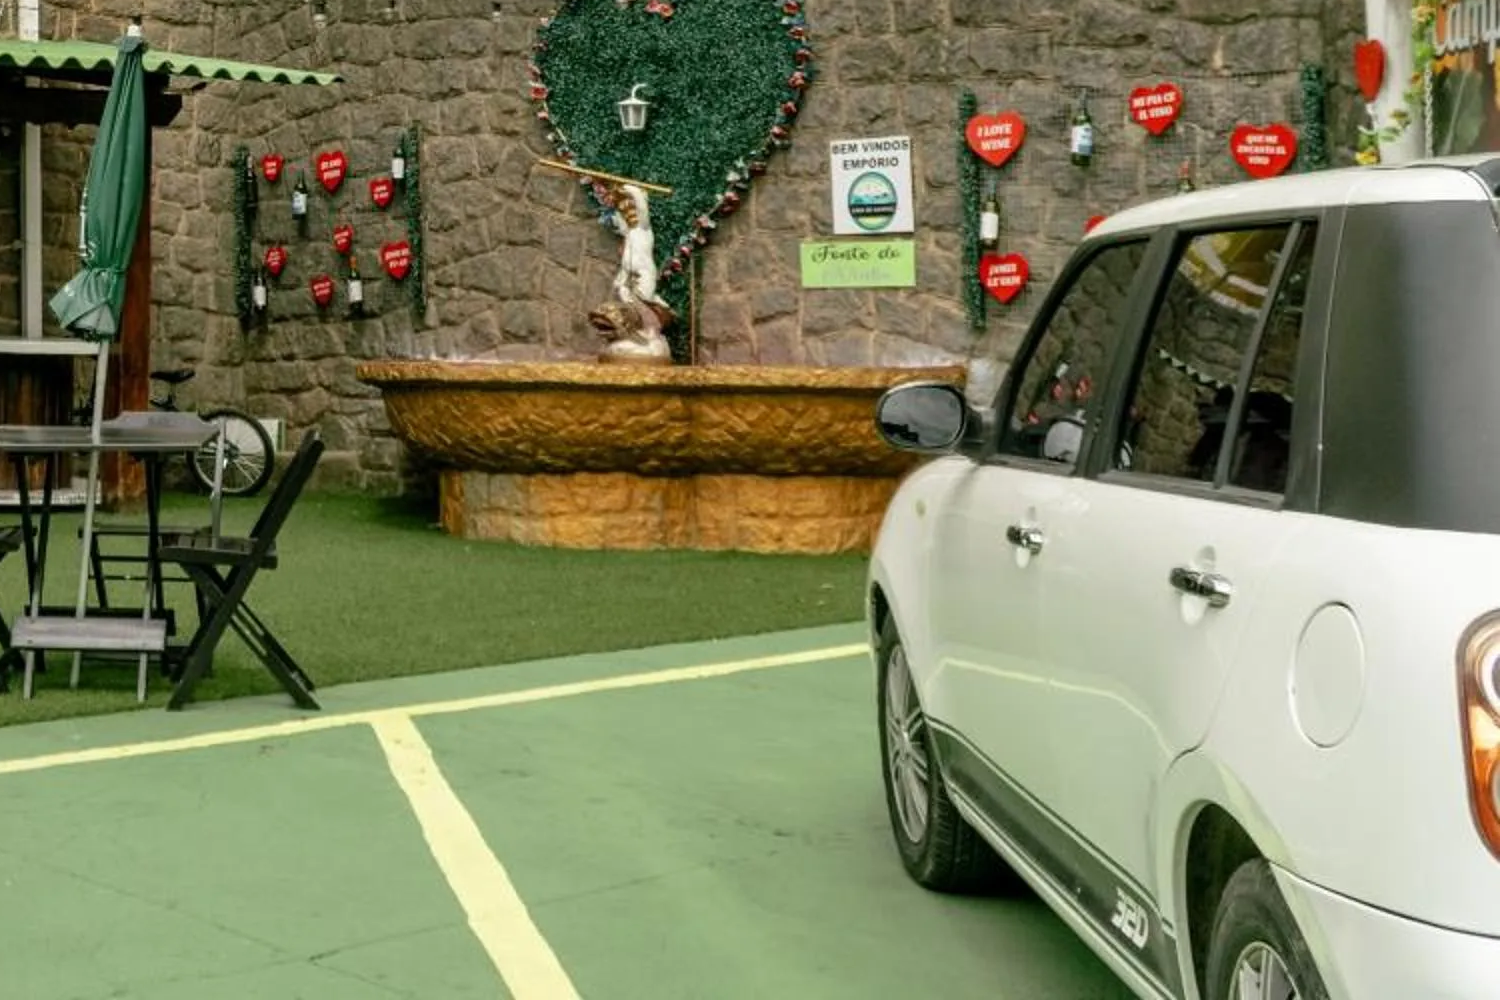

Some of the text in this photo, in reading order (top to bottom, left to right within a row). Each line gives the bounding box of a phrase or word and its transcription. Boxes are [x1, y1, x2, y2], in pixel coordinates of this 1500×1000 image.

[984, 123, 1013, 137] LOVE
[832, 140, 909, 155] BEM VINDOS
[981, 137, 1011, 151] WINE
